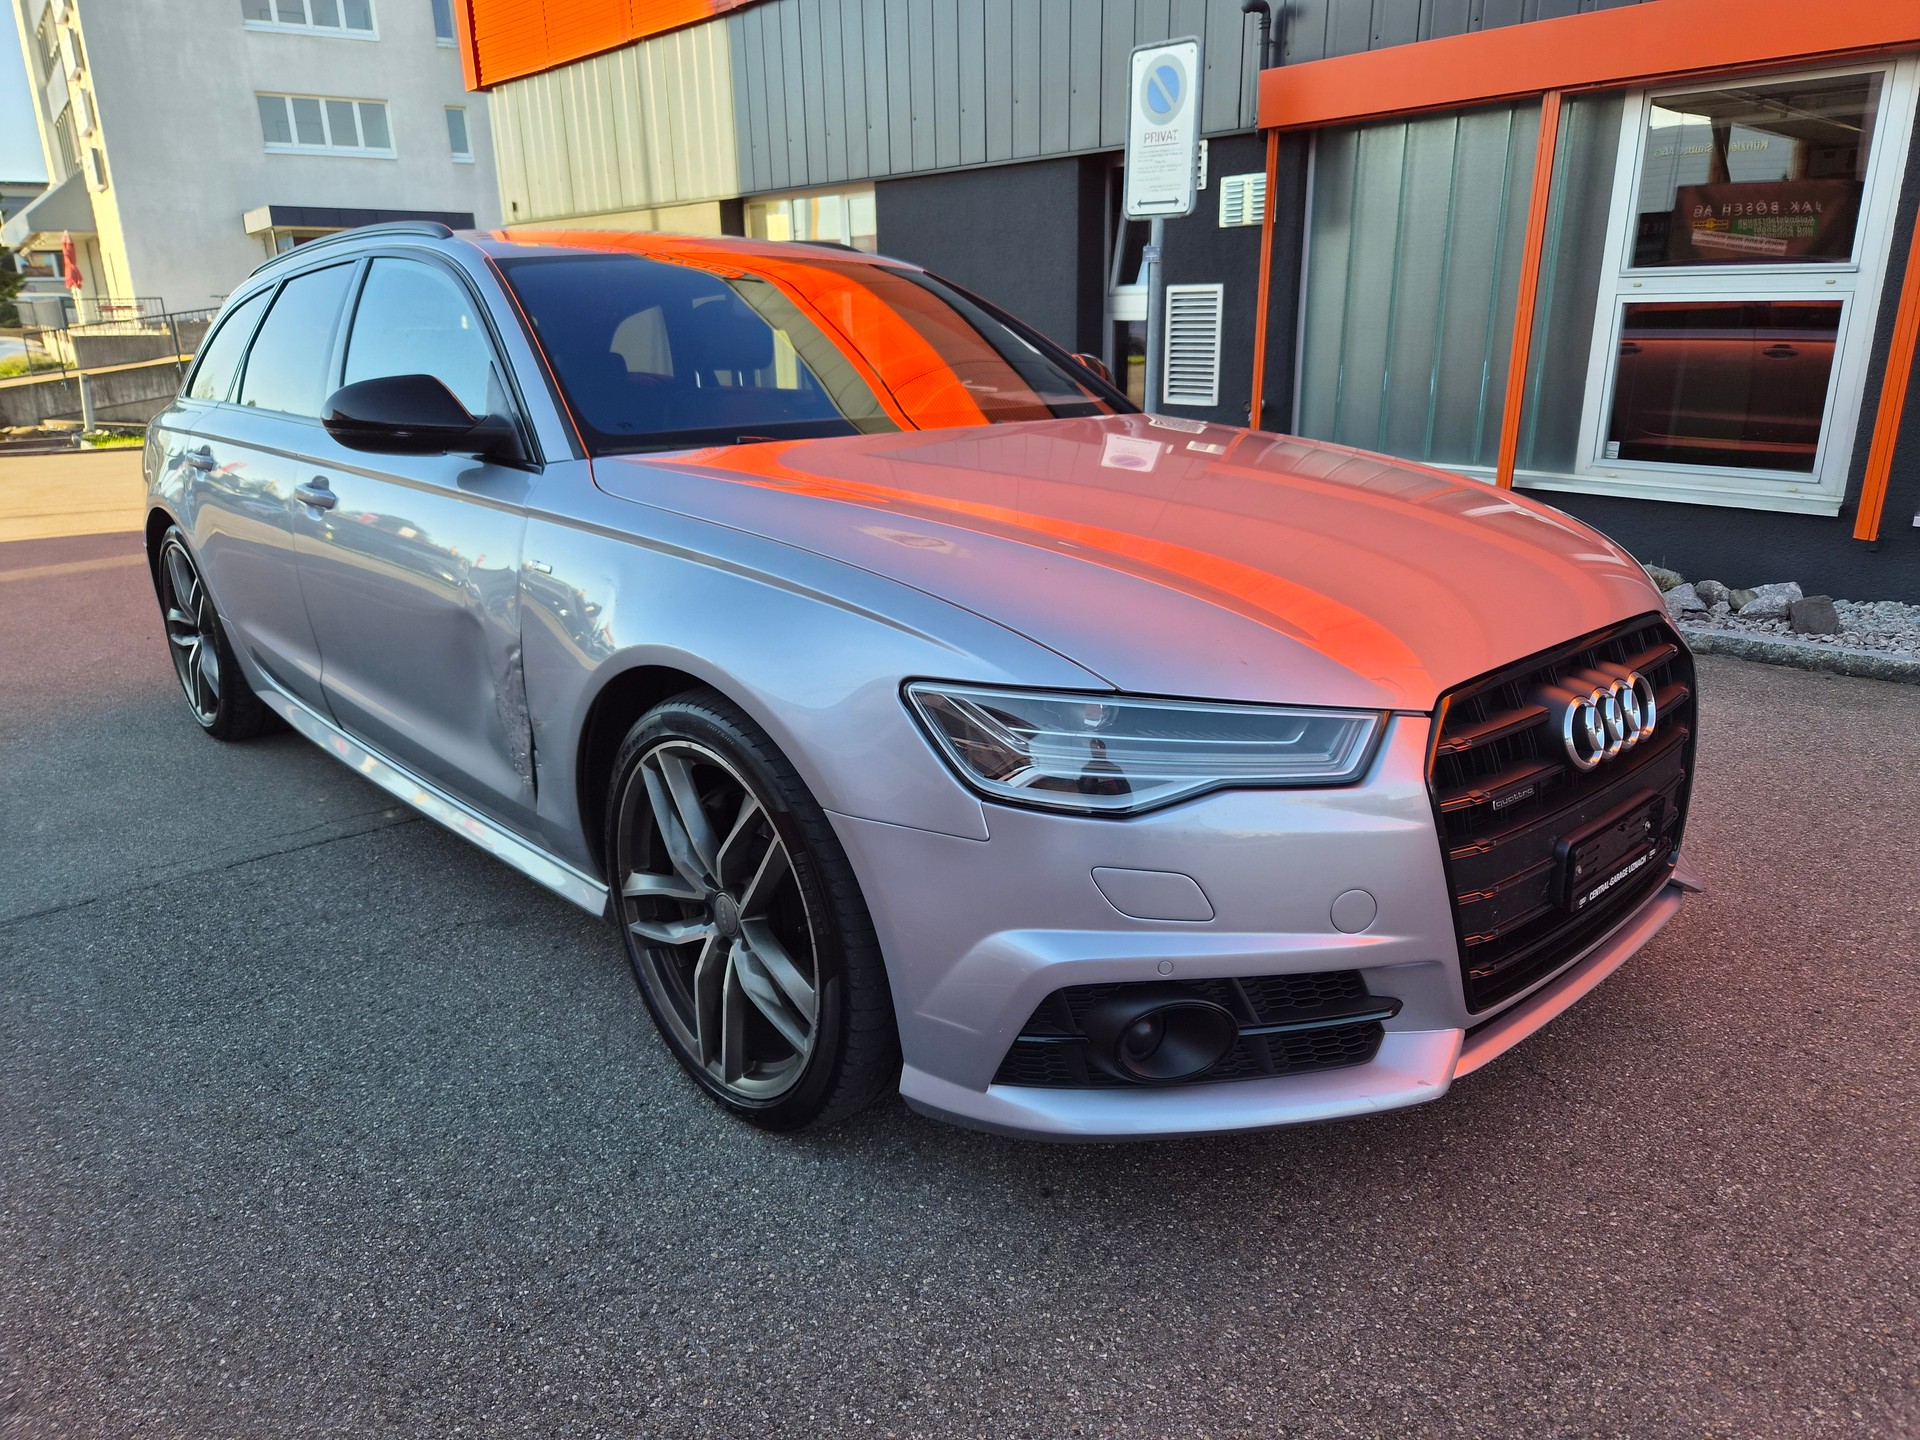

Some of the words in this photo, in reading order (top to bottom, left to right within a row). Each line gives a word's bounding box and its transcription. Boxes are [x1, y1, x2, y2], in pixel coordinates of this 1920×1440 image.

[1143, 129, 1179, 144] PRIVAT
[1495, 787, 1533, 808] quattro
[1589, 867, 1629, 901] CENTRAL-GARAGE
[1628, 854, 1647, 873] UZNACH
